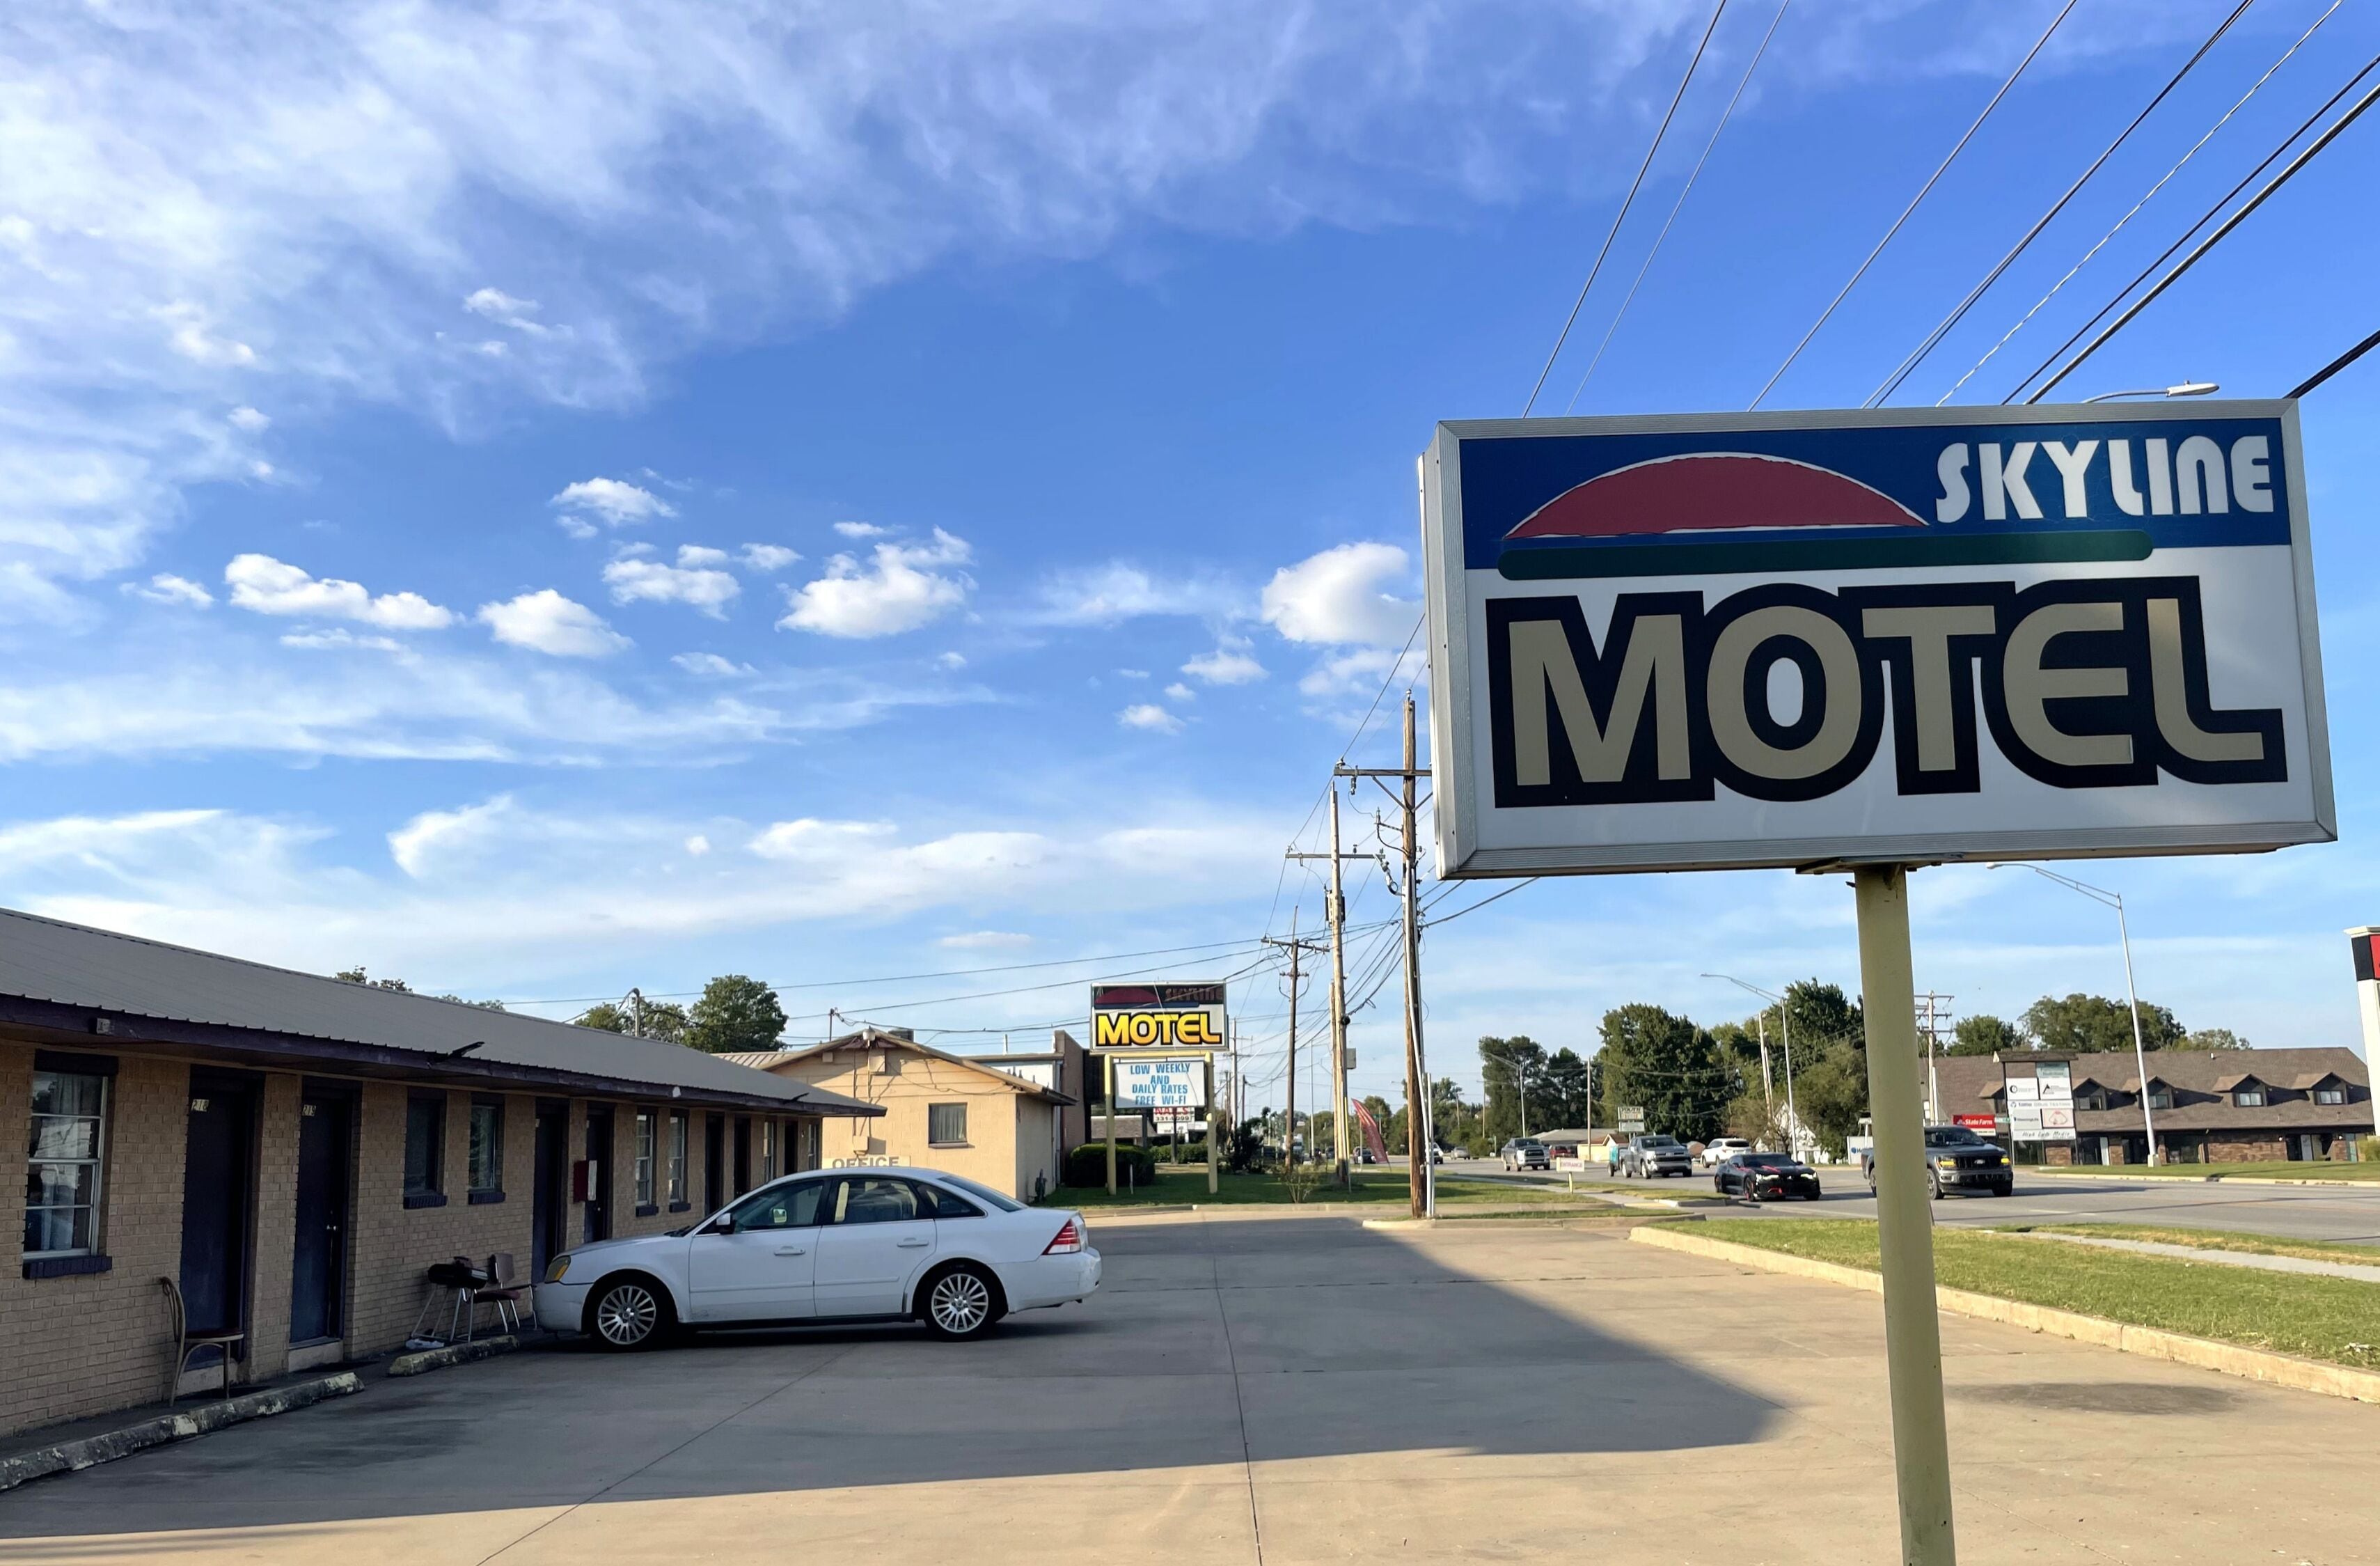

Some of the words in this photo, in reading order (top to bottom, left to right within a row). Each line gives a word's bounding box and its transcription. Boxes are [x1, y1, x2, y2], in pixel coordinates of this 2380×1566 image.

[1936, 435, 2274, 524] SKYLINE
[1486, 575, 2287, 808] MOTEL
[1096, 1012, 1222, 1046] MOTEL
[1130, 1064, 1150, 1074] LOW
[1156, 1063, 1190, 1073] WEEKLY
[1151, 1075, 1169, 1084] AND
[1132, 1084, 1156, 1093] DAILY
[1161, 1084, 1188, 1094] RATES
[1135, 1095, 1155, 1105] FREE
[1163, 1095, 1186, 1105] WI-FI
[833, 1157, 899, 1169] OFFICE
